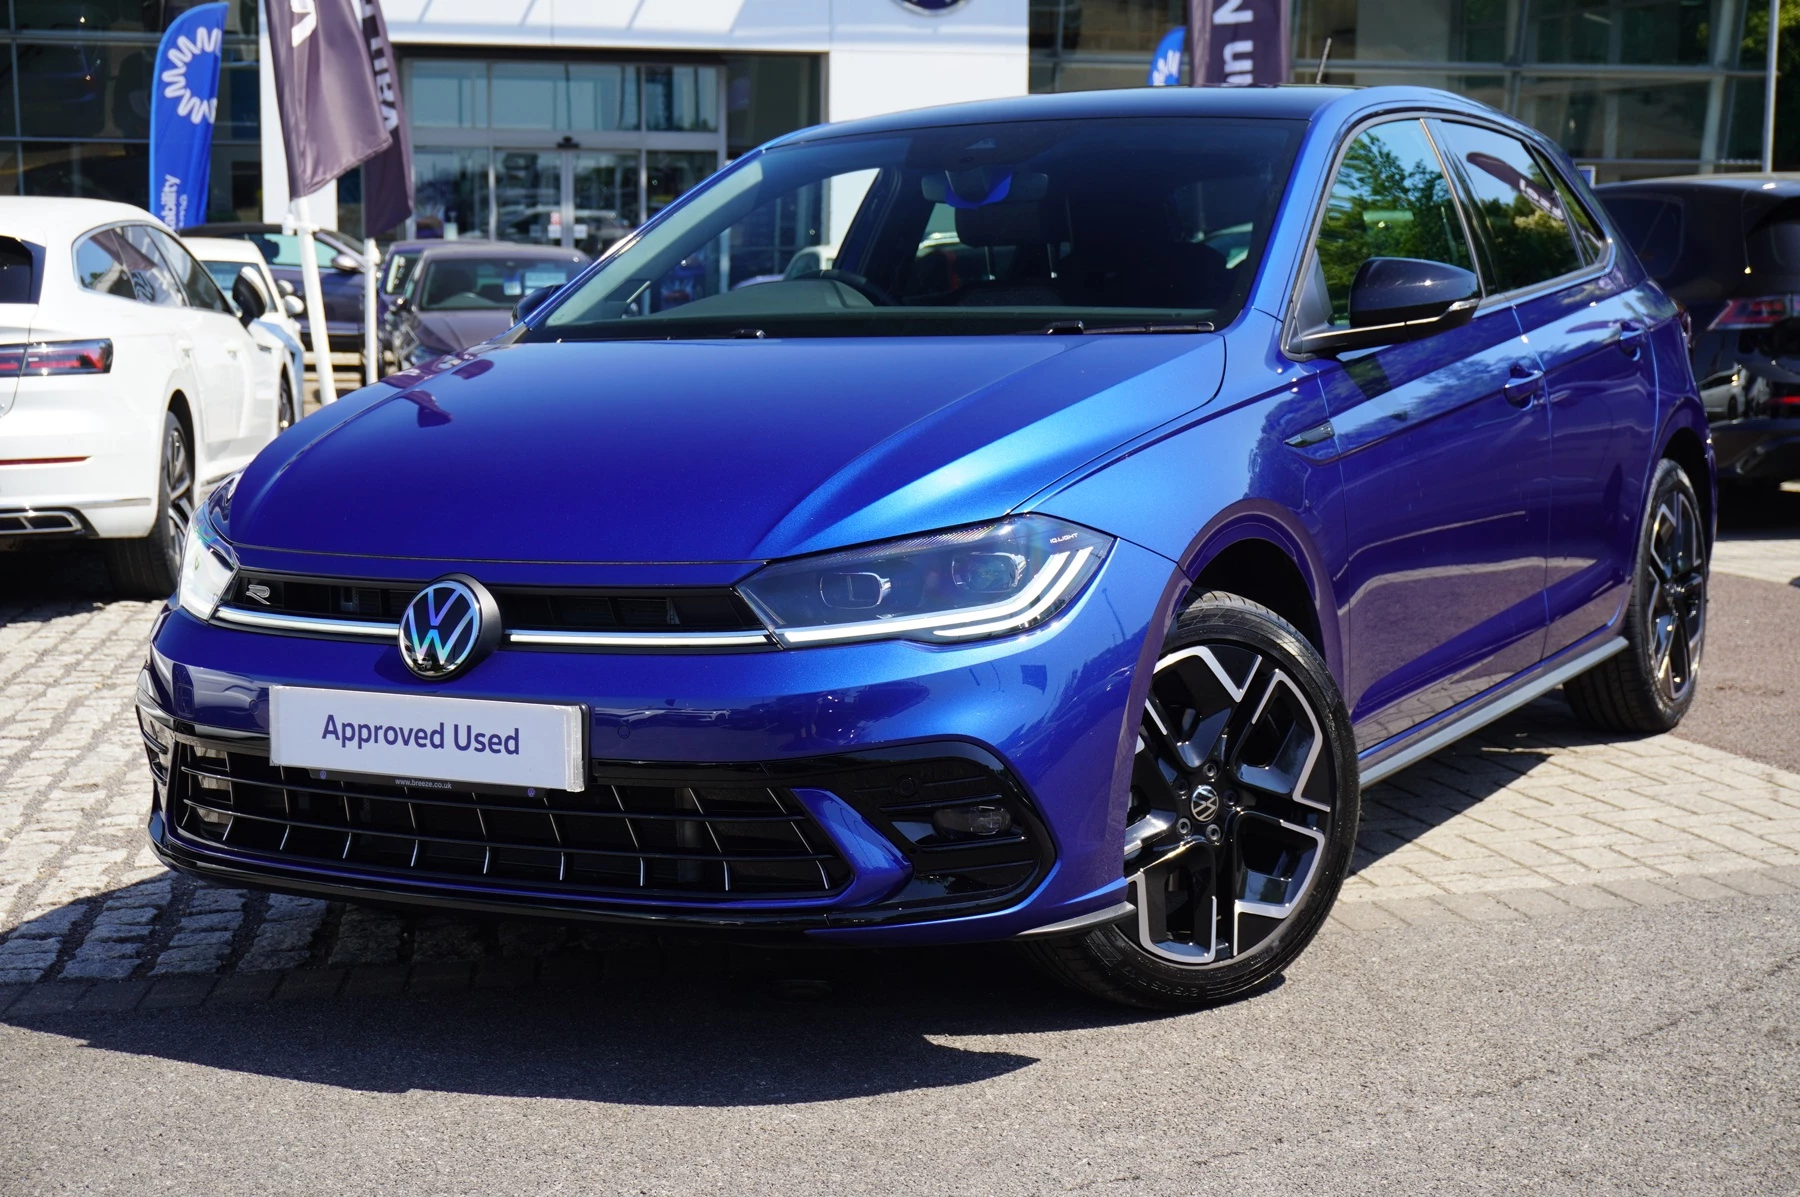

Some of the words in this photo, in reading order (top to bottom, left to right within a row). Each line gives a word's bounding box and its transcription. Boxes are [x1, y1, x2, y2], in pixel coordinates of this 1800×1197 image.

[161, 173, 181, 231] ability
[321, 714, 445, 750] Approved
[453, 723, 520, 755] Used
[394, 779, 452, 789] www.breeze.co.uk
